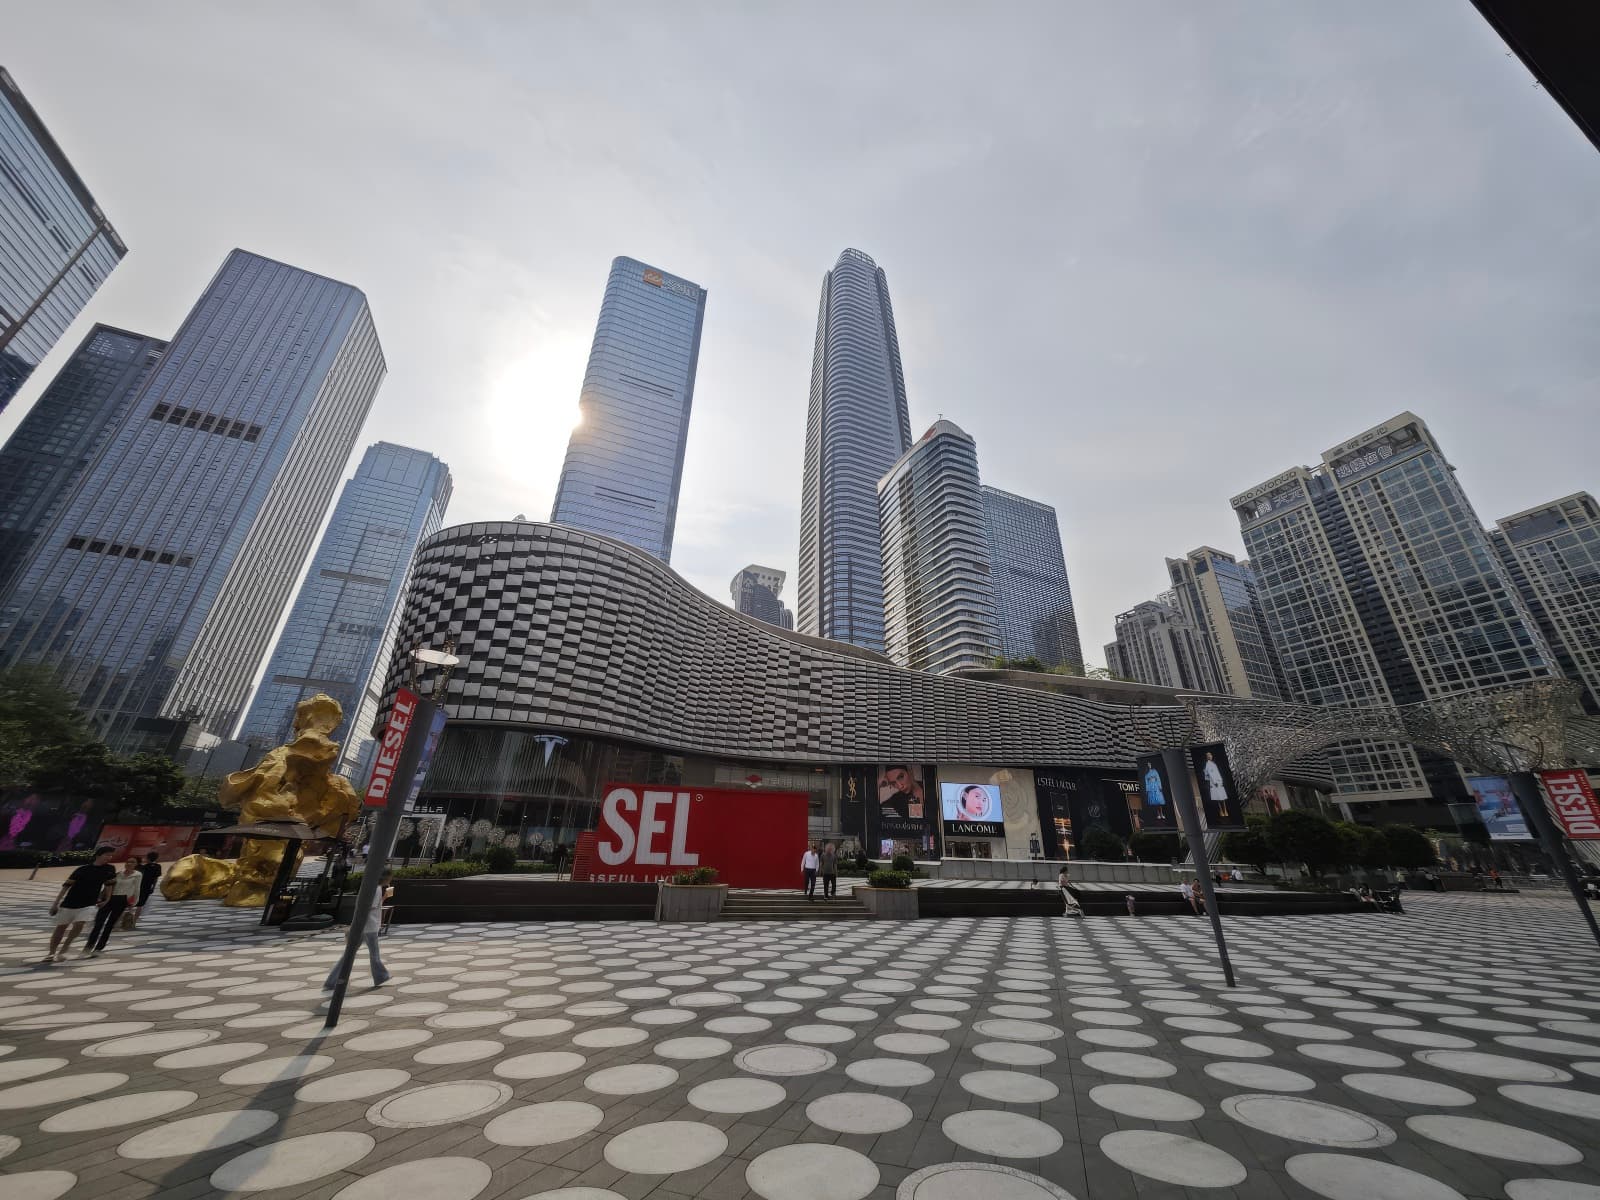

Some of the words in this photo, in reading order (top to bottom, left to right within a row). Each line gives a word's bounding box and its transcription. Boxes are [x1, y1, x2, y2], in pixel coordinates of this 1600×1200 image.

[368, 701, 413, 798] DIESEL
[414, 805, 443, 814] ESLA
[1117, 782, 1135, 792] TOM
[1546, 774, 1600, 834] DIESEL
[598, 788, 699, 866] SEL
